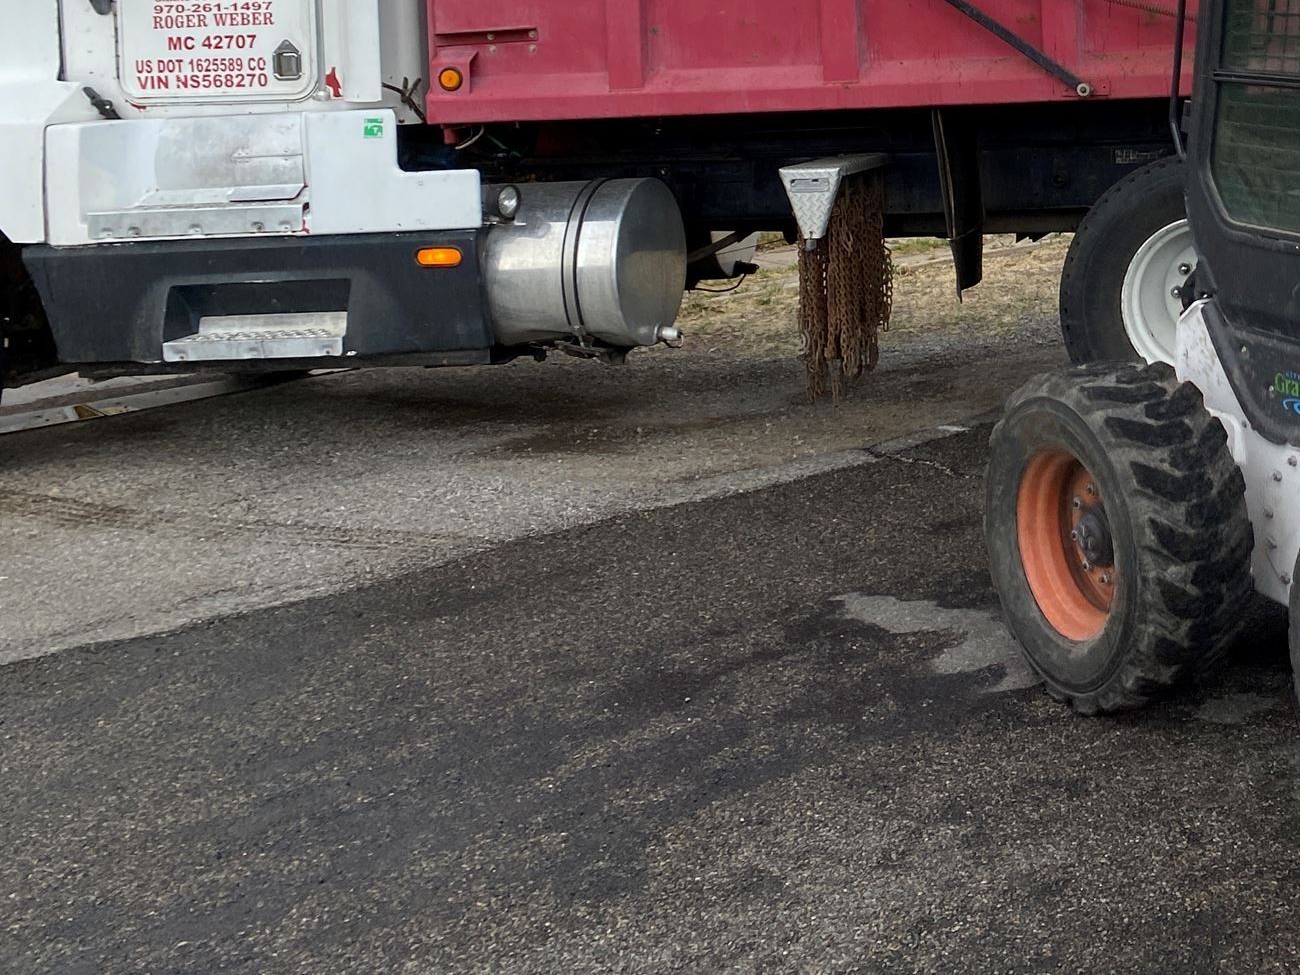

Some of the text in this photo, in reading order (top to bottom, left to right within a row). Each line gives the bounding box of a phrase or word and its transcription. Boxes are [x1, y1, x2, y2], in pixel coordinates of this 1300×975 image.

[153, 1, 273, 14] 970-261-1497
[153, 11, 275, 29] ROGER WEBER
[168, 34, 257, 51] MC 42707
[135, 57, 267, 74] US DOT 1625589 CO
[137, 73, 268, 90] VIN NS568270
